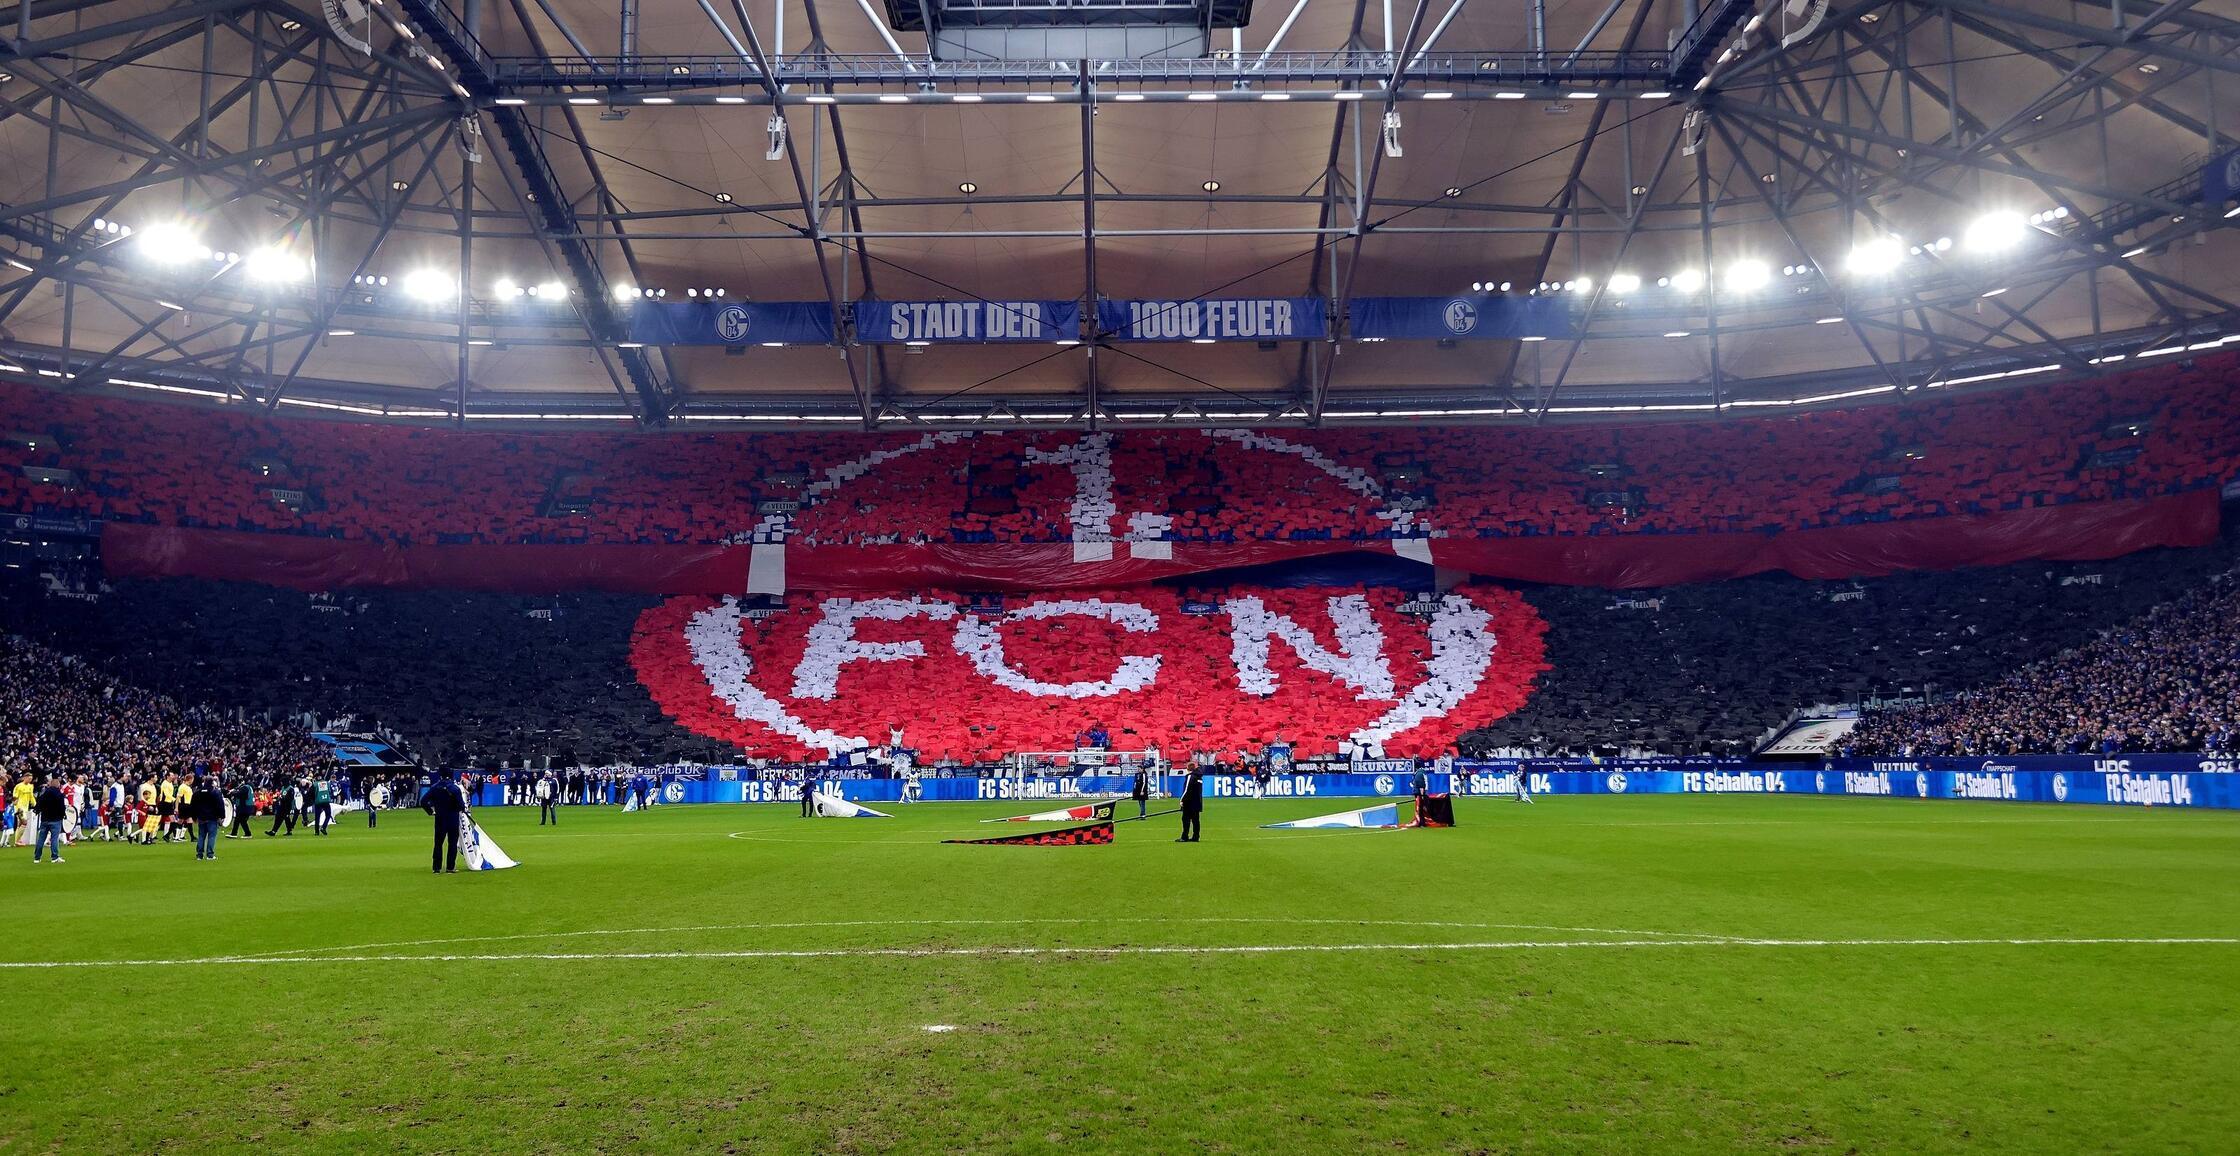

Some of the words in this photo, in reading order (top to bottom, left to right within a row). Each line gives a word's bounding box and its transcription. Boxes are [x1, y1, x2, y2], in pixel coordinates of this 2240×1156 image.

[891, 302, 975, 340] STADT
[986, 302, 1041, 338] DER
[1131, 301, 1199, 338] 1000
[1207, 300, 1291, 337] FEUER
[684, 767, 702, 775] UK
[741, 781, 760, 801] FC
[978, 779, 996, 799] FC
[999, 778, 1057, 798] Schalke
[1060, 778, 1080, 793] 04
[1214, 776, 1232, 796] FC
[1295, 775, 1316, 795] 04
[1530, 773, 1551, 793] 04
[1683, 772, 1702, 792] FC
[1704, 772, 1763, 792] Schalke
[1765, 772, 1785, 792] 04
[1966, 773, 2001, 798] Schalke
[2001, 773, 2016, 798] 04
[2106, 774, 2121, 802] FC
[2122, 774, 2171, 804] Schalke
[2171, 774, 2192, 804] 04
